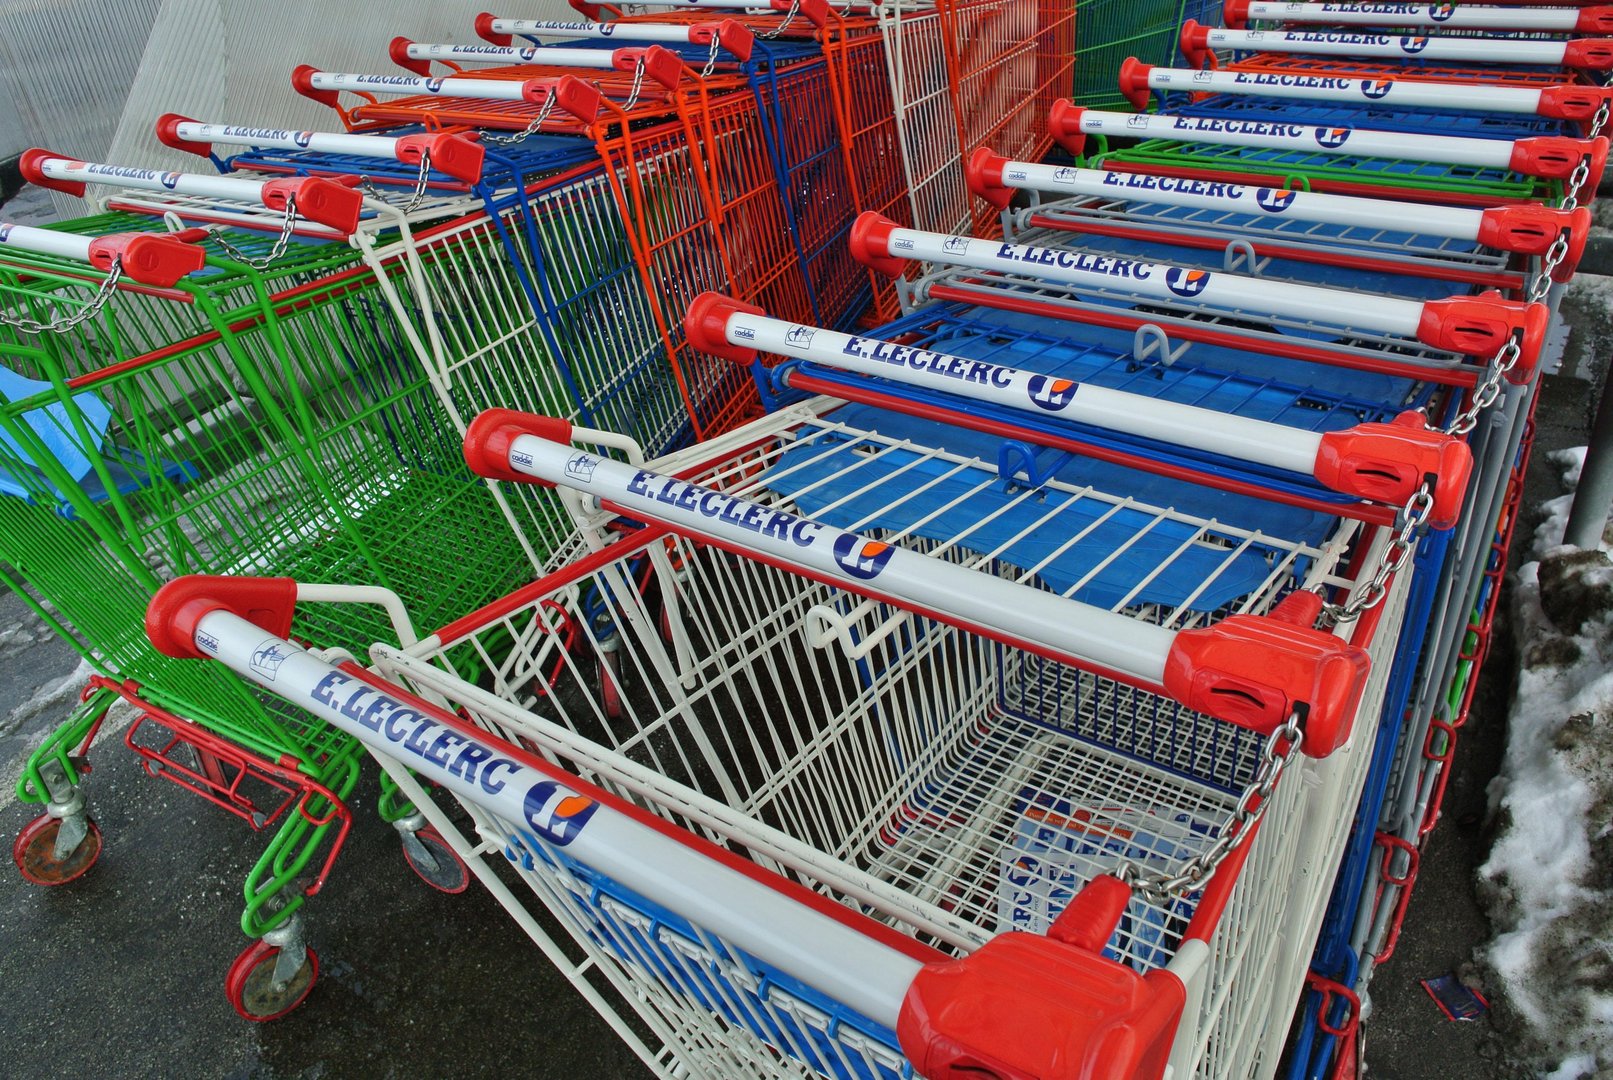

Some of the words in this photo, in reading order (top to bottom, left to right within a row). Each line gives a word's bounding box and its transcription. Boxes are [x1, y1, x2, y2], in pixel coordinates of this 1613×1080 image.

[1173, 117, 1304, 138] E.LECLERC
[1103, 171, 1246, 199] E.LECLERC
[894, 240, 914, 249] caddie
[996, 243, 1155, 281] E.LECLERC
[734, 327, 755, 340] caddie
[842, 336, 1017, 389] E.LECLERC
[511, 452, 533, 467] caddie
[626, 469, 826, 548] E.LECLERC
[196, 633, 219, 653] caddie
[310, 669, 524, 796] E.LECLERC
